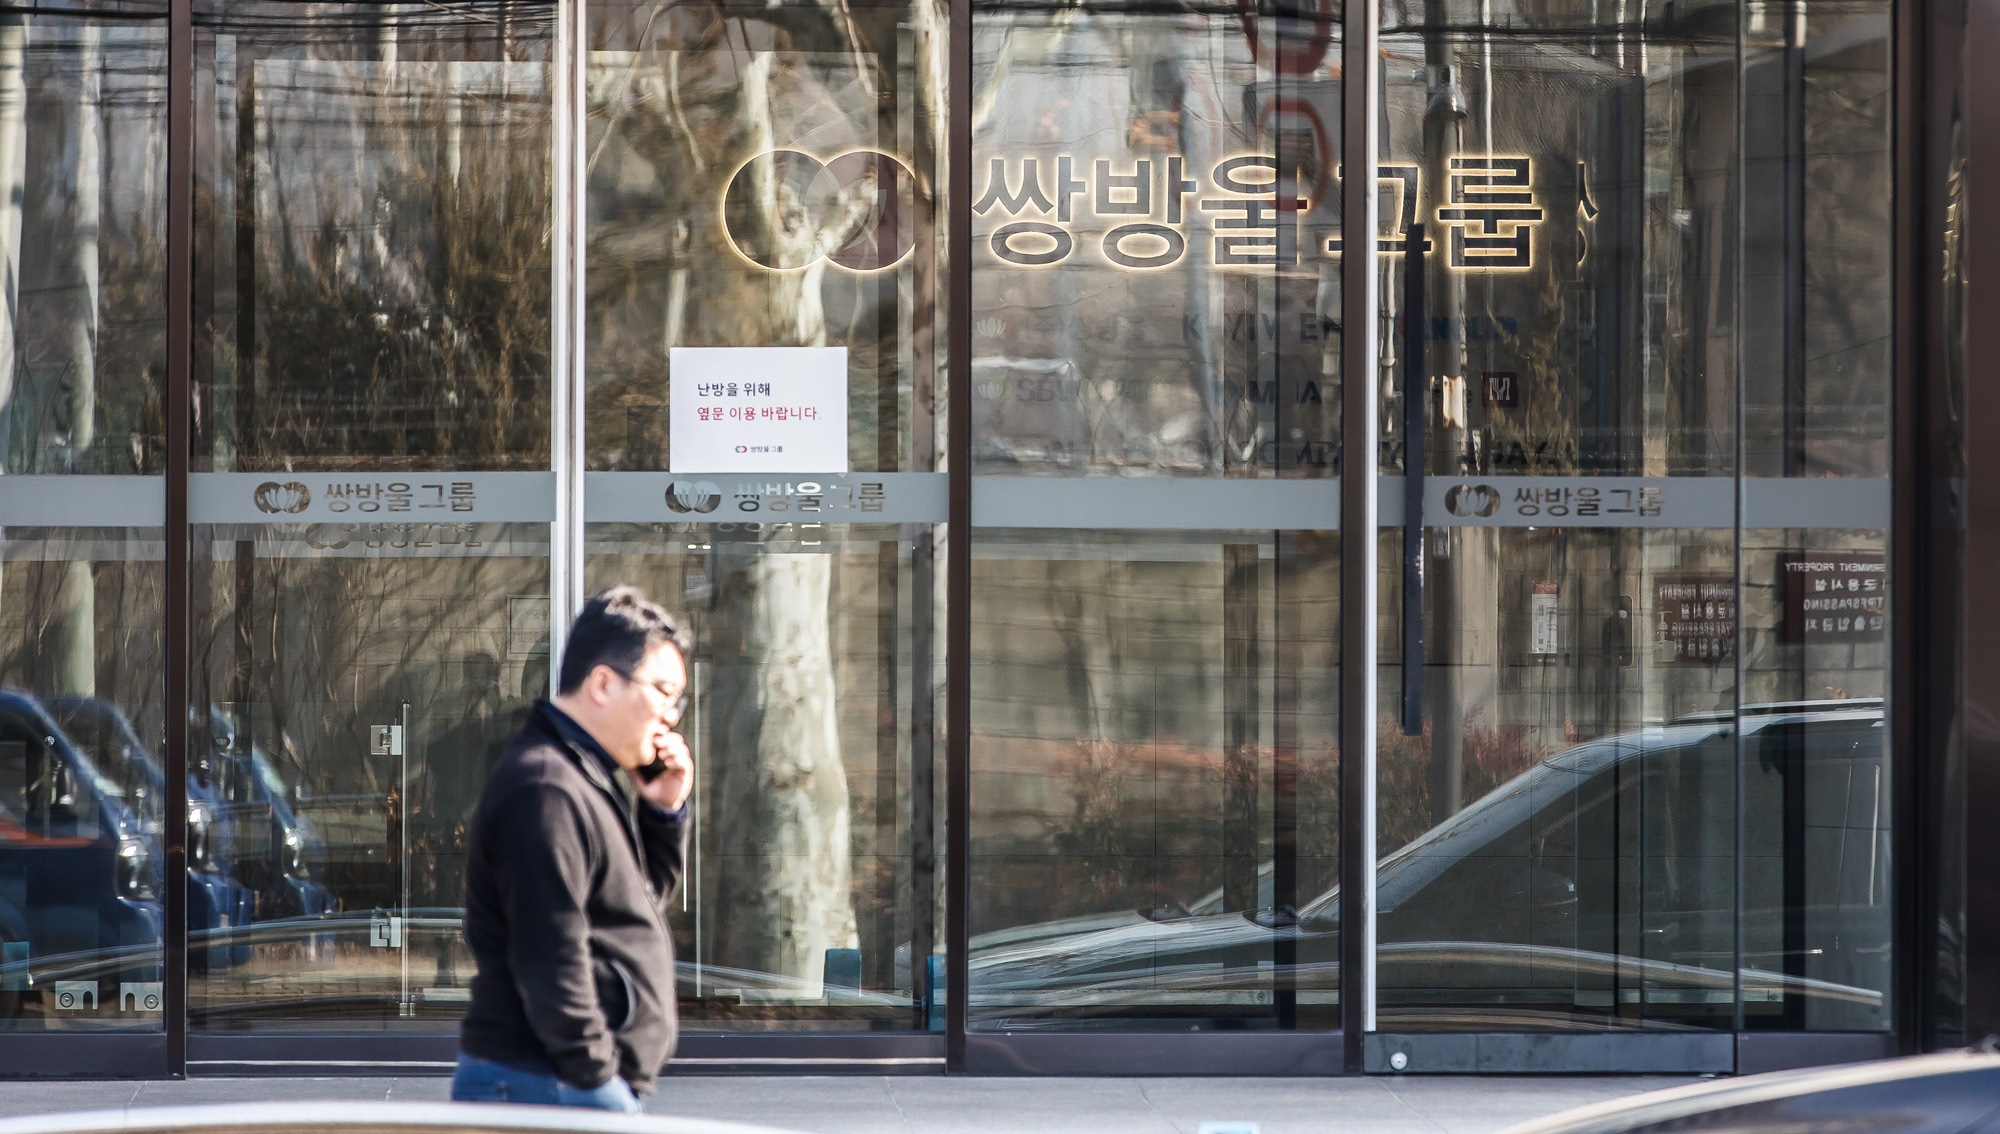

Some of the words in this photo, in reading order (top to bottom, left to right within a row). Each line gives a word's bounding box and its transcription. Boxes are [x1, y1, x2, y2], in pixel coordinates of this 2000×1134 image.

[697, 382, 739, 397] 난방을
[743, 382, 771, 397] 위해
[697, 406, 725, 421] 옆문
[729, 406, 757, 421] 이용
[761, 406, 821, 421] 바랍니다.
[325, 482, 477, 513] 쌍방울그룹
[733, 481, 886, 513] 쌍방울그룹
[1513, 487, 1663, 517] 쌍방울그룹
